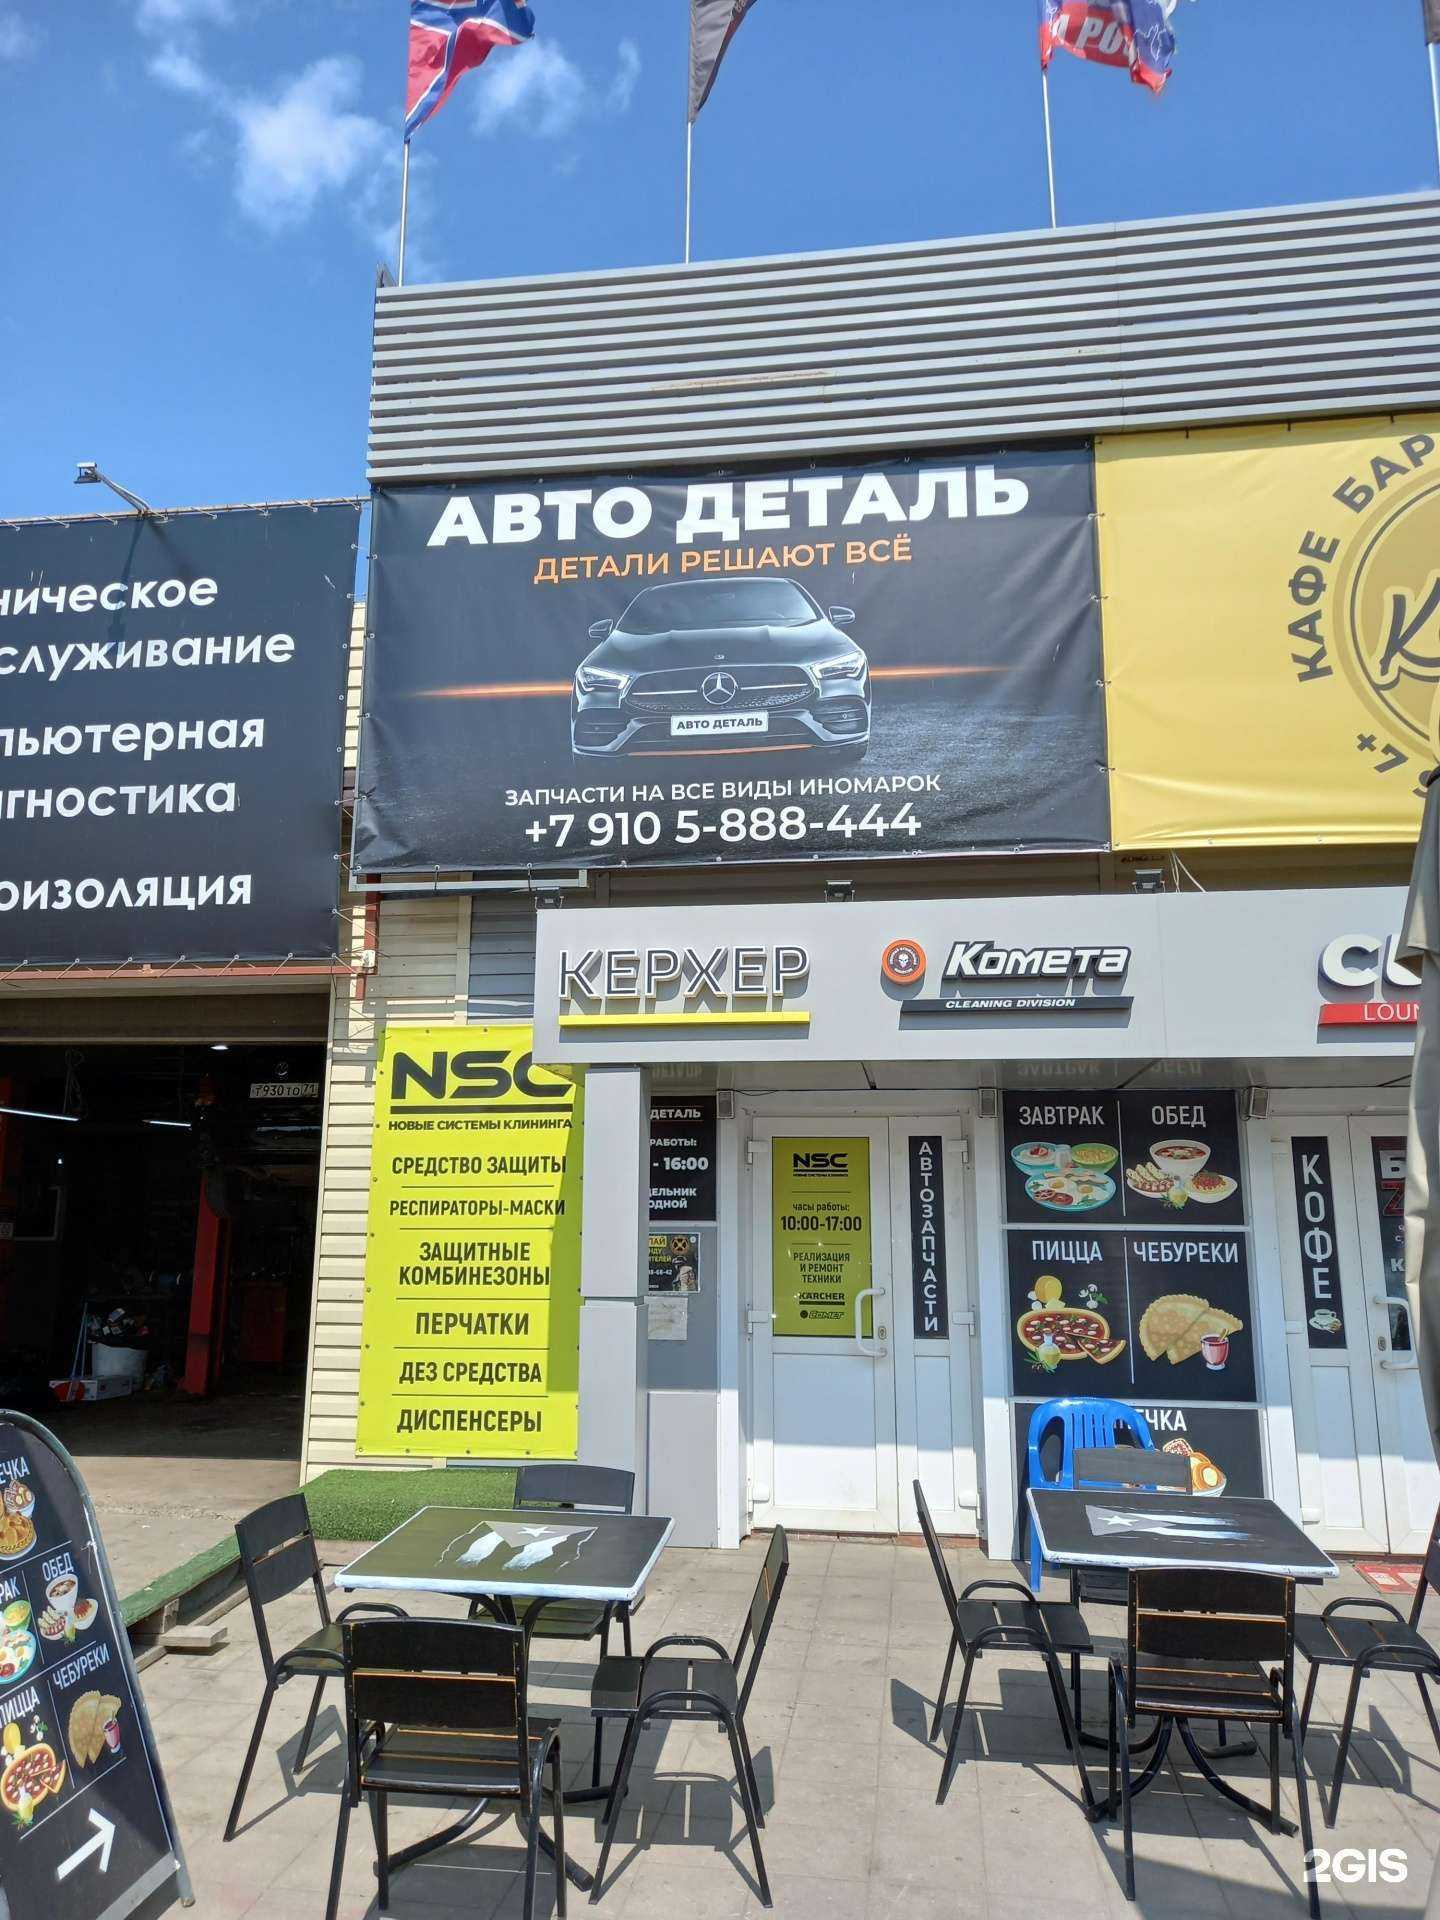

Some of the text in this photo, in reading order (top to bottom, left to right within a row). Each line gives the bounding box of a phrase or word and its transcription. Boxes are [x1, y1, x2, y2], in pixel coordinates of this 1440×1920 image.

[427, 465, 1030, 546] АВТО ДЕТАЛЬ
[534, 533, 912, 585] ДЕТАЛИ РЕШАЮТ ВСЁ
[1288, 433, 1436, 682] КАФЕ БАР
[0, 633, 295, 681] служивание
[676, 718, 763, 730] АВТО ДЕТАЛЬ
[505, 775, 941, 806] ЗАПЧАСТИ НА ВСЕ ВИДЫ ИНОМАРОК
[525, 802, 922, 847] +7 910 5-888-444
[0, 874, 252, 911] оизоляция
[559, 946, 809, 999] КЕРХЕР
[945, 998, 1075, 1009] CLEANING DIVISION
[391, 1050, 574, 1099] NSC
[388, 1118, 573, 1131] НОВЫЕ СИСТЕМЫ КЛИНИНГА
[650, 1109, 701, 1119] ДЕТАЛЬ
[1019, 1105, 1105, 1126] ЗАВТРАК
[1151, 1105, 1207, 1128] ОБЕД
[392, 1155, 567, 1176] СРЕДСТВО ЗАЩИТЫ
[663, 1157, 709, 1170] 16:00
[793, 1153, 848, 1168] NSC
[649, 1187, 697, 1197] ЕЛЬНИК
[390, 1200, 565, 1216] РЕСПИРАТОРЫ-МАСКИ
[793, 1202, 850, 1213] часы работы:
[781, 1216, 862, 1231] 10:00-17:00
[1301, 1154, 1332, 1299] КОФЕ
[919, 1141, 938, 1331] АВТОЗАПЧАСТИ
[419, 1242, 531, 1263] ЗАЩИТНЫЕ
[793, 1252, 850, 1263] РЕАЛИЗАЦИЯ
[1032, 1240, 1102, 1264] ПИЦЦА
[1133, 1241, 1239, 1263] ЧЕБУРЕКИ
[399, 1266, 550, 1286] КОМБИНЕЗОНЫ
[800, 1264, 843, 1273] И РЕМОНТ
[802, 1275, 841, 1283] ТЕХНИКИ
[416, 1313, 529, 1335] ПЕРЧАТКИ
[399, 1362, 542, 1385] ДЕЗ СРЕДСТВА
[397, 1409, 541, 1433] ДИСПЕНСЕРЫ
[42, 1552, 73, 1582] ОБЕД
[53, 1643, 110, 1690] ЧЕБУРЕКИ
